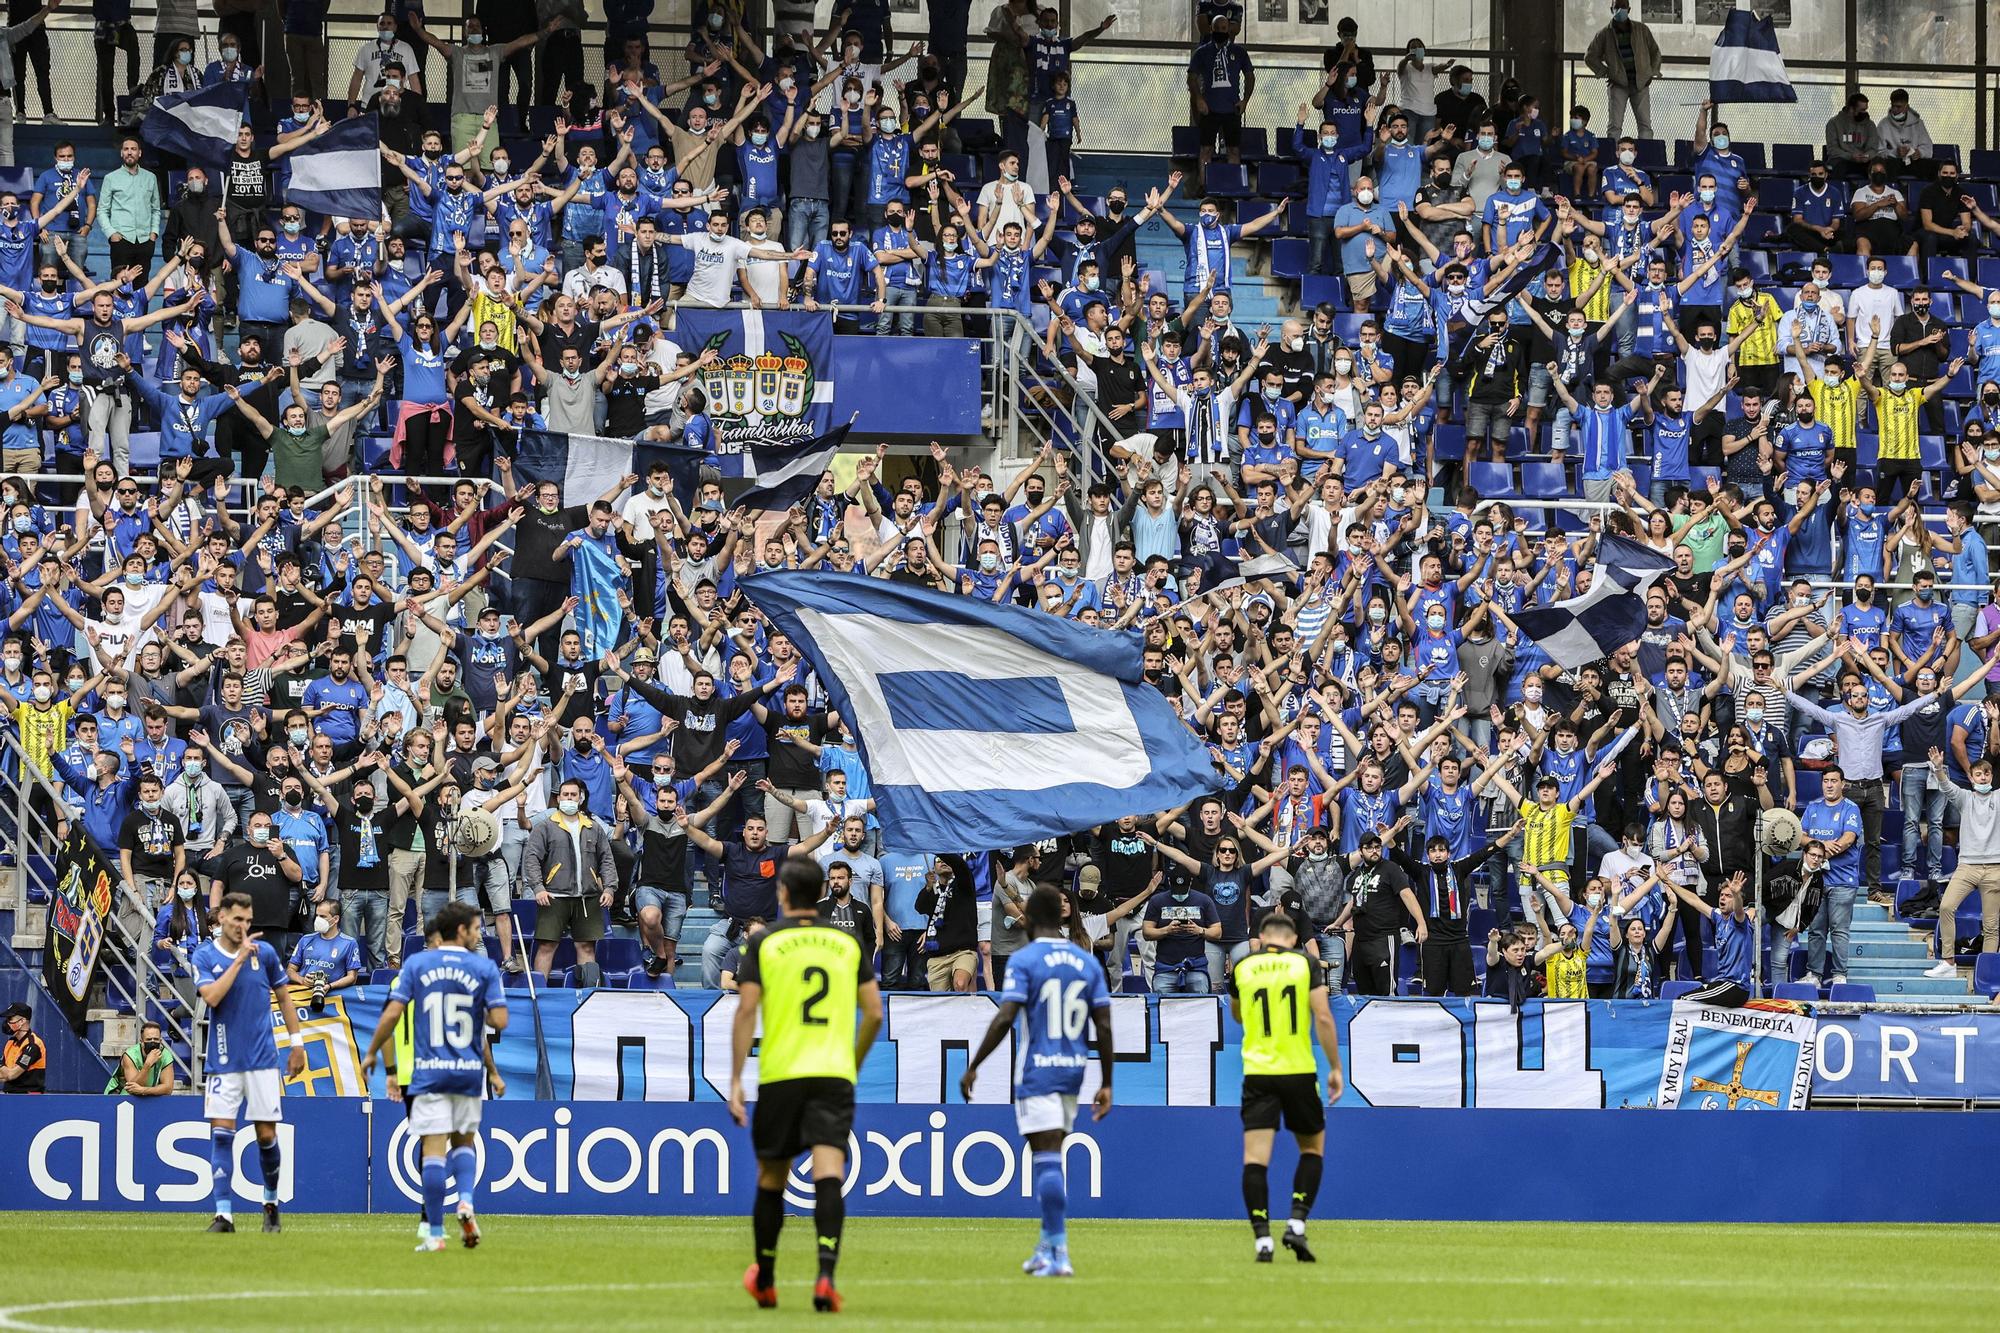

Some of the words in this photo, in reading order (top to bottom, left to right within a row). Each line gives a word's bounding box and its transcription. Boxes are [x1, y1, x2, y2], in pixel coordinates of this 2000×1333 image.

[1147, 221, 1160, 231] 23
[100, 632, 129, 645] FILA
[246, 856, 254, 864] 12
[1856, 945, 1864, 955] 6
[802, 966, 829, 1026] 2
[1896, 982, 1904, 993] 5
[423, 991, 474, 1049] 15
[1040, 978, 1088, 1040] 16
[1254, 985, 1297, 1037] 11
[1700, 1010, 1795, 1034] BENEMERITA
[1673, 1019, 1688, 1055] LEAL
[415, 1058, 456, 1069] Tartiere
[457, 1060, 482, 1071] Auto
[1665, 1058, 1682, 1092] MUY
[28, 1101, 295, 1204] alsa
